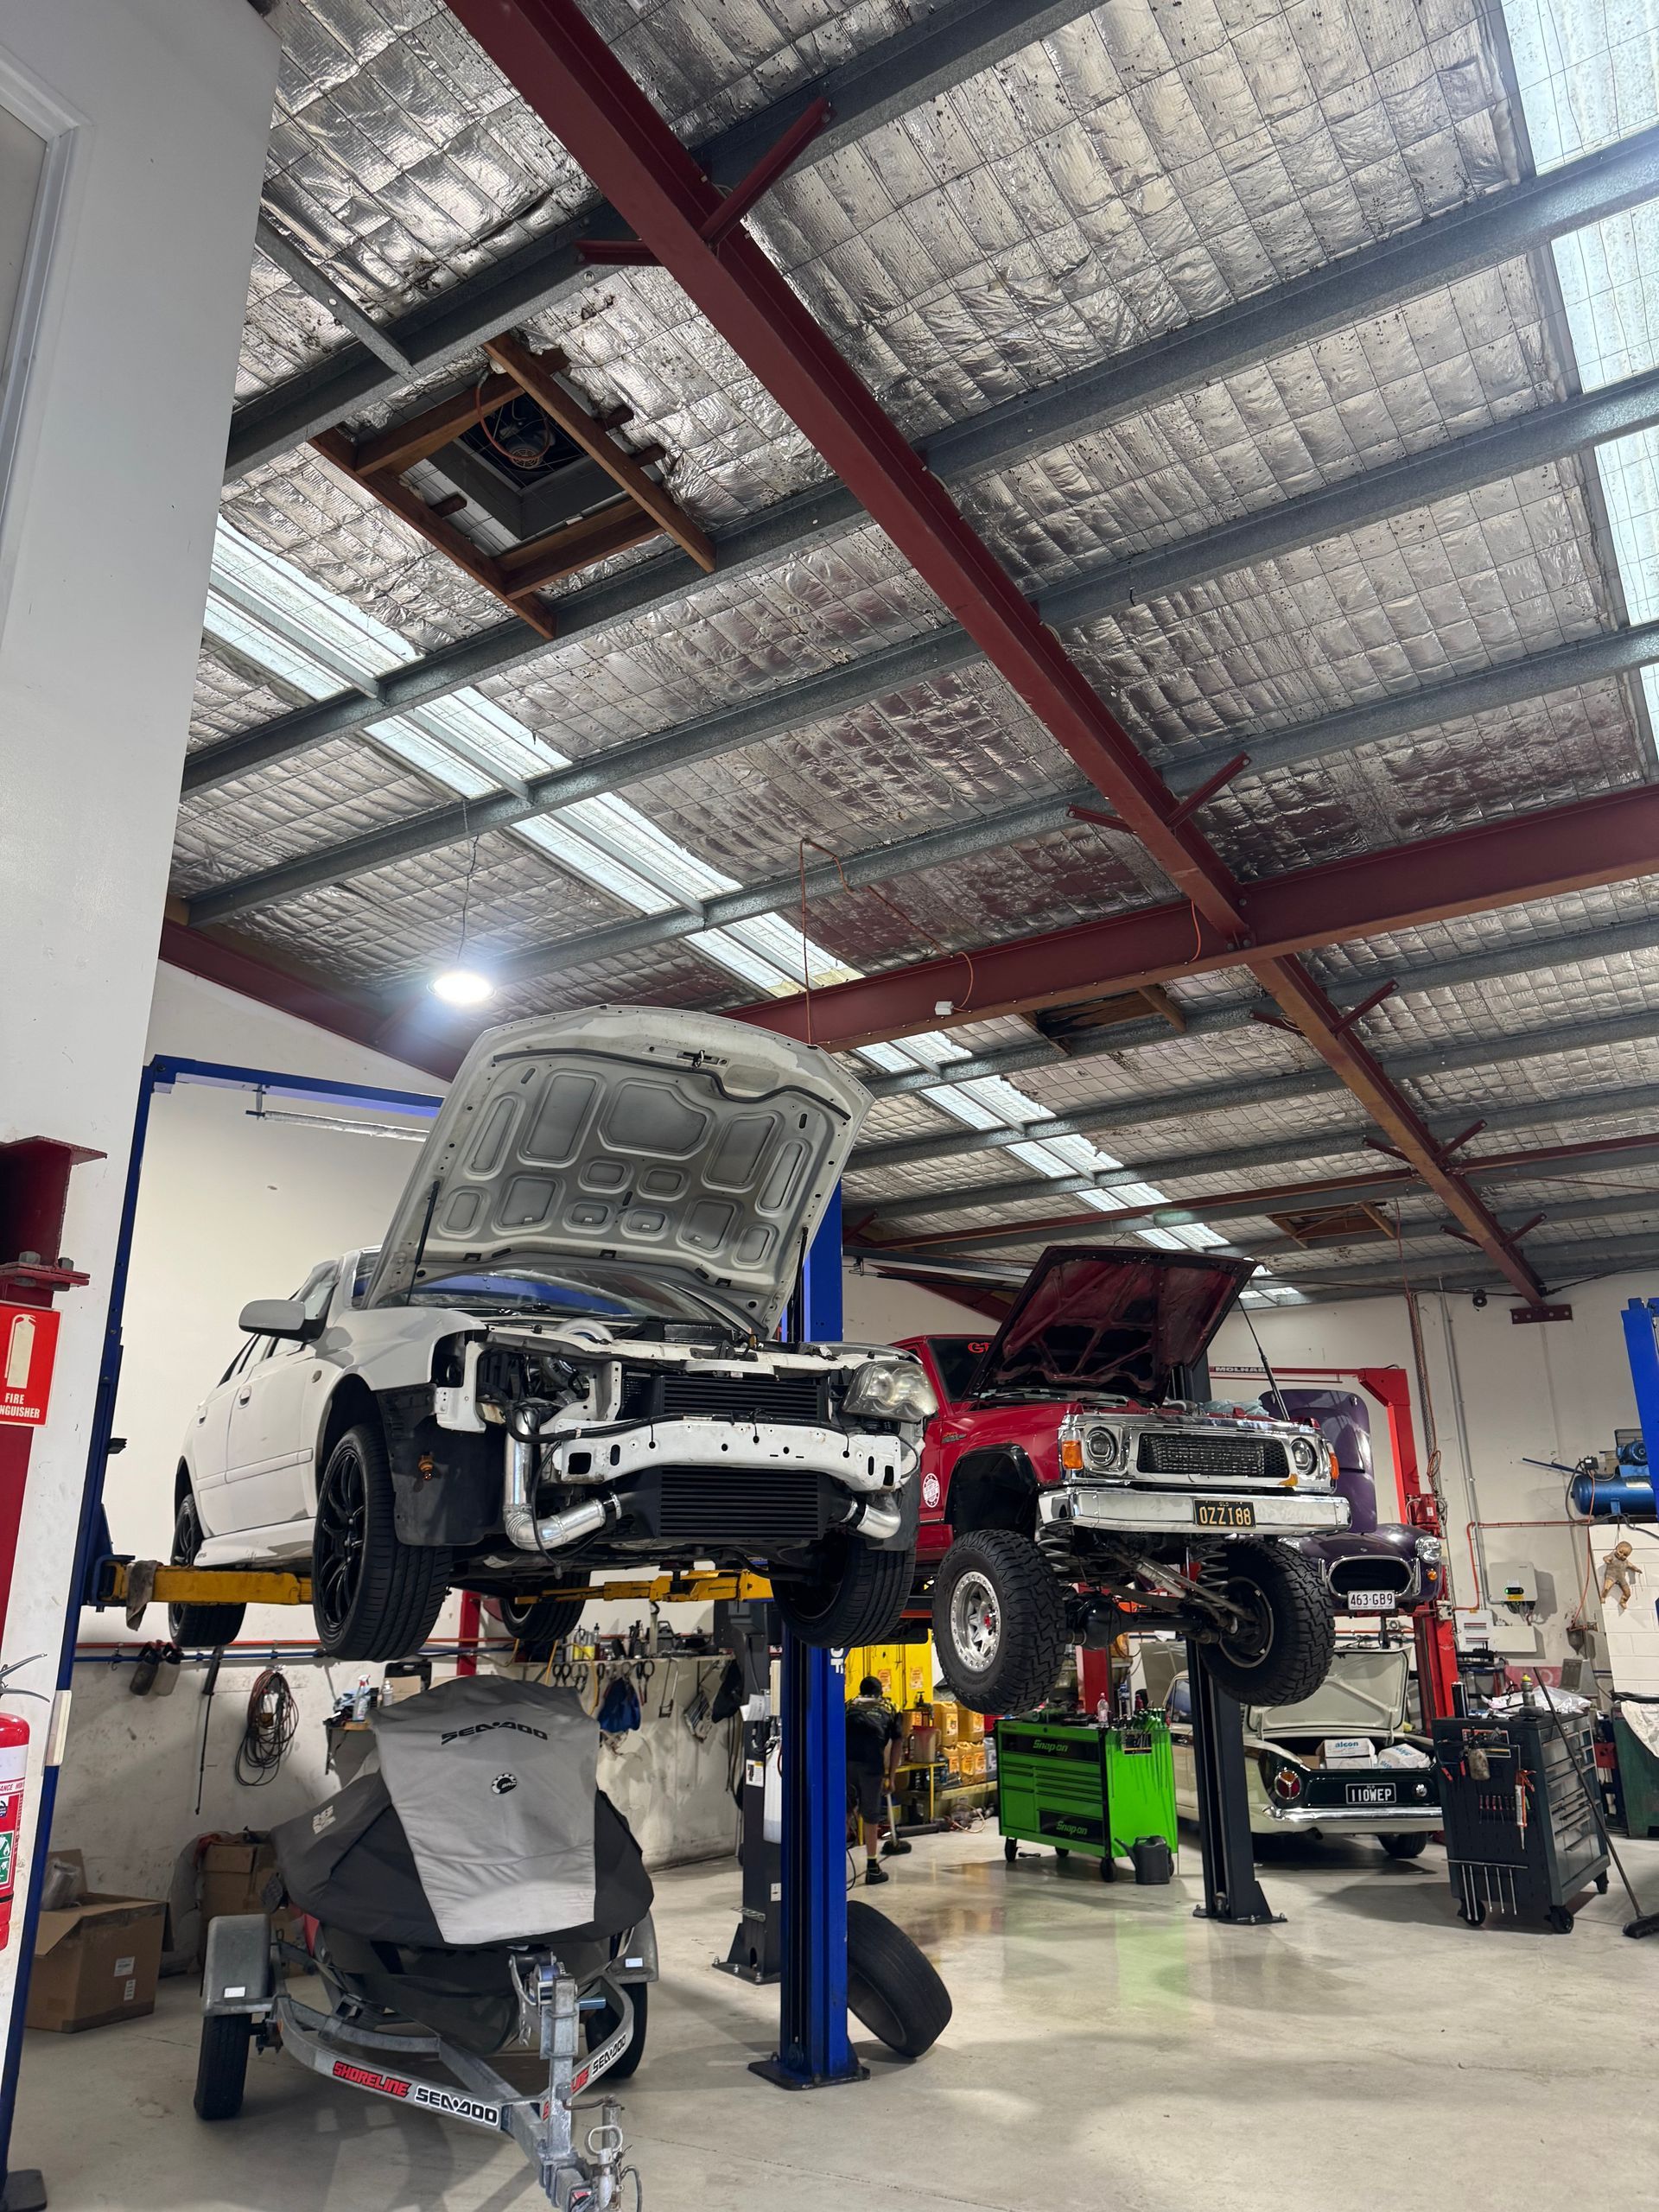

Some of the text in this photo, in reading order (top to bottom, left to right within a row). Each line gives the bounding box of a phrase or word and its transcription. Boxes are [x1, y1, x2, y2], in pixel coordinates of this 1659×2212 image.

[4, 1392, 25, 1405] FIRE
[1334, 1740, 1359, 1749] alcon
[333, 2061, 412, 2098] SHORELINE
